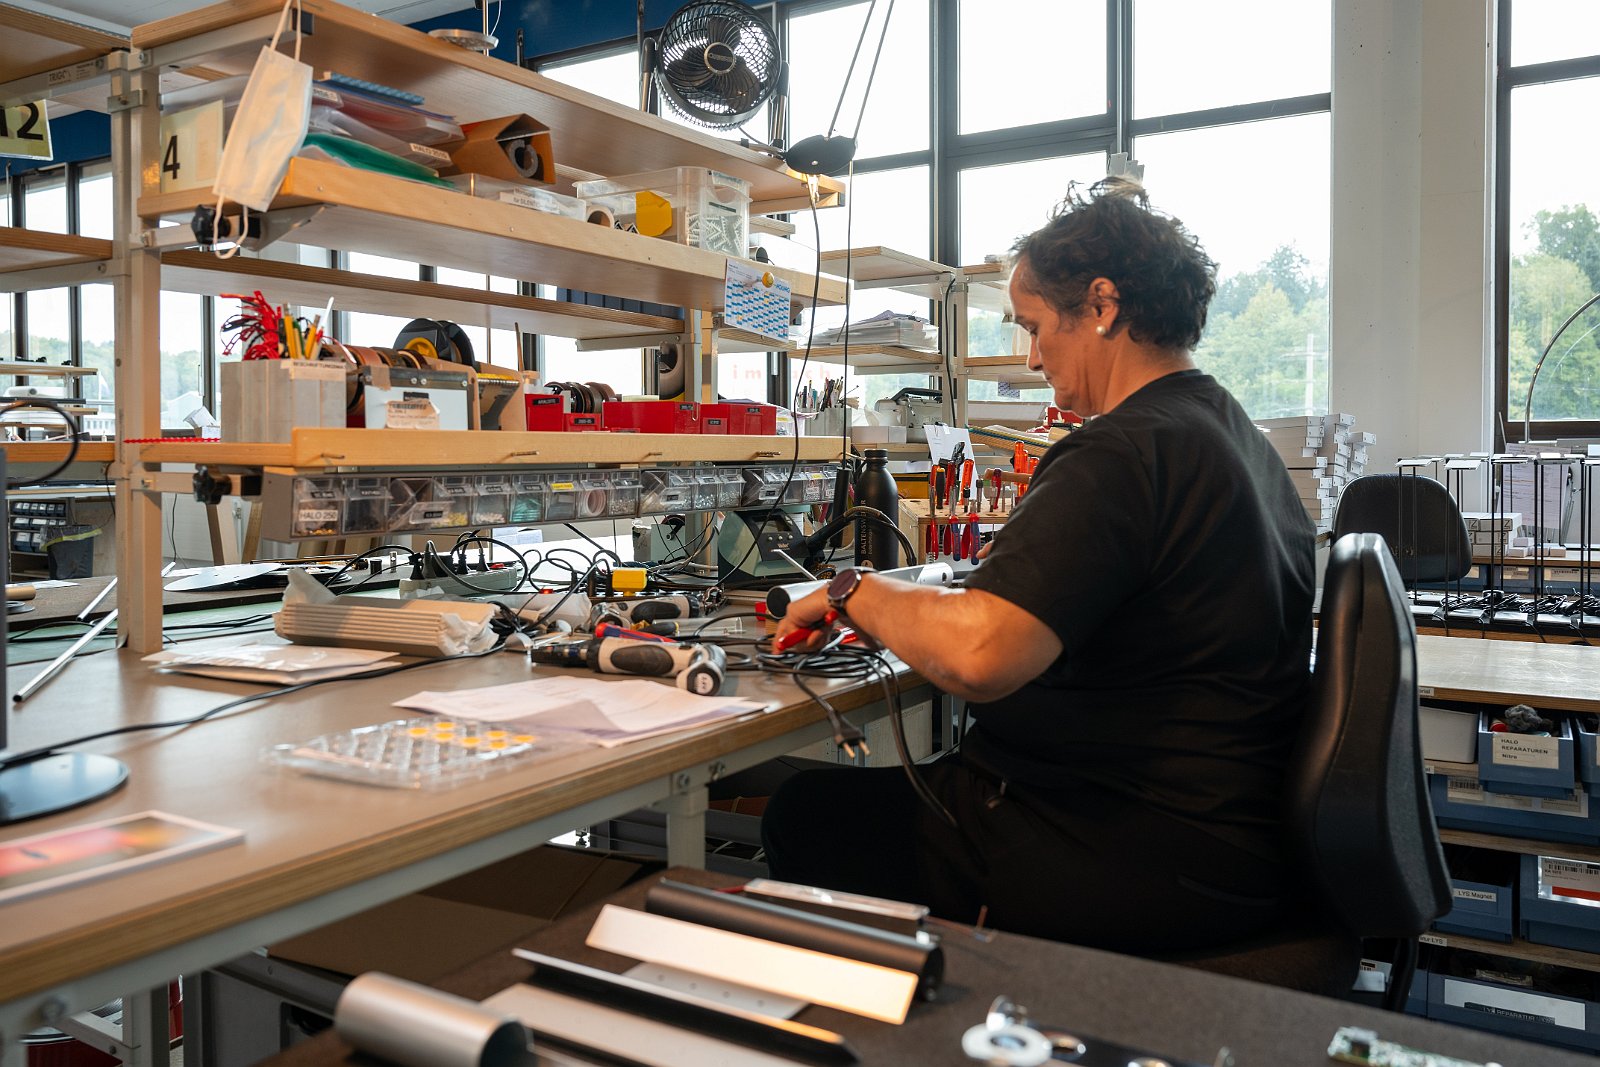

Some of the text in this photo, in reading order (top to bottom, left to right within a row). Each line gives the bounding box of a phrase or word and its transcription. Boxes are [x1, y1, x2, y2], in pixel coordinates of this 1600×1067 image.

[0, 102, 44, 140] 12
[163, 135, 180, 179] 4
[300, 510, 336, 520] HALO 250
[1501, 745, 1548, 755] REPARATUREN
[1471, 892, 1493, 900] Magnet
